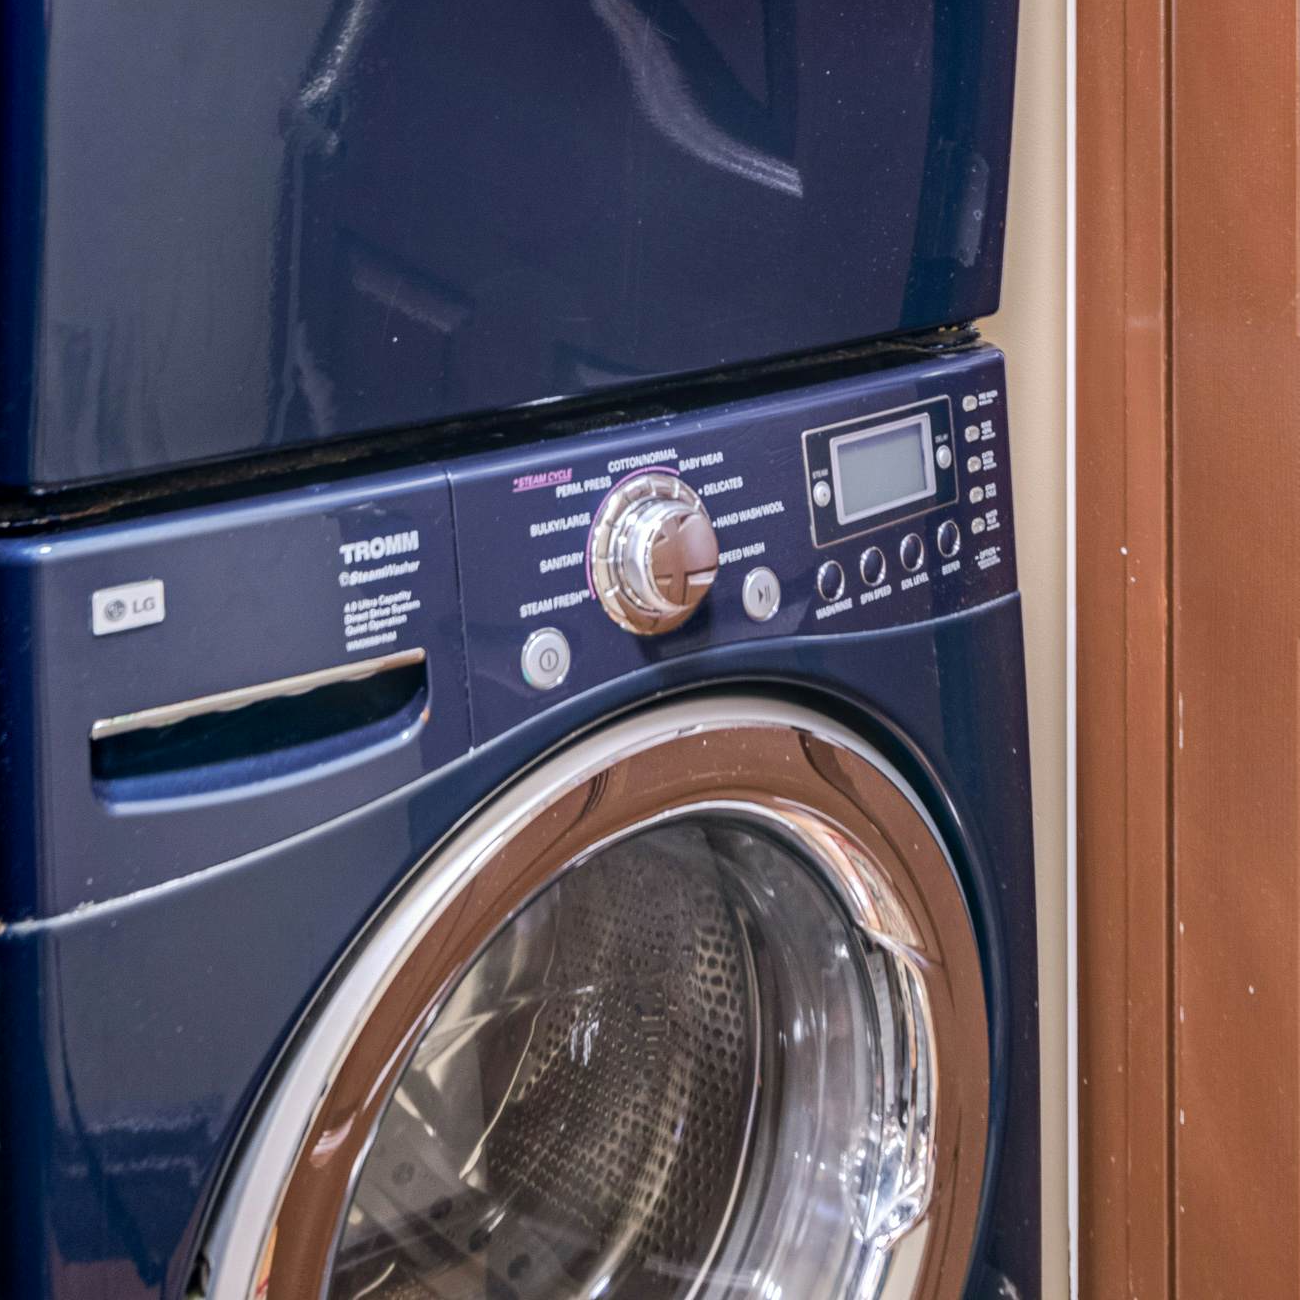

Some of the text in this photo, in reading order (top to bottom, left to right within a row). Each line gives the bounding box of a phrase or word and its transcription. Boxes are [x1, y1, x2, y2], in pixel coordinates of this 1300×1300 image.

[607, 448, 678, 473] COTTON/NORMAL
[679, 451, 724, 472] BABY WEAR
[548, 468, 573, 483] CYCLE
[583, 475, 612, 493] PRESS
[703, 476, 743, 496] DELICATES
[716, 500, 785, 528] HAND WASH/WOOL
[529, 512, 591, 537] BULKY/LARGE
[339, 530, 419, 565] TROMM
[718, 541, 766, 566] SPEED WASH
[539, 551, 584, 574] SANITARY
[349, 561, 420, 587] SteamWasher
[133, 597, 155, 614] LG
[378, 590, 412, 606] Capacity
[519, 598, 553, 618] STEAM
[369, 606, 391, 619] Drive
[391, 600, 421, 615] System
[368, 614, 408, 632] Operation
